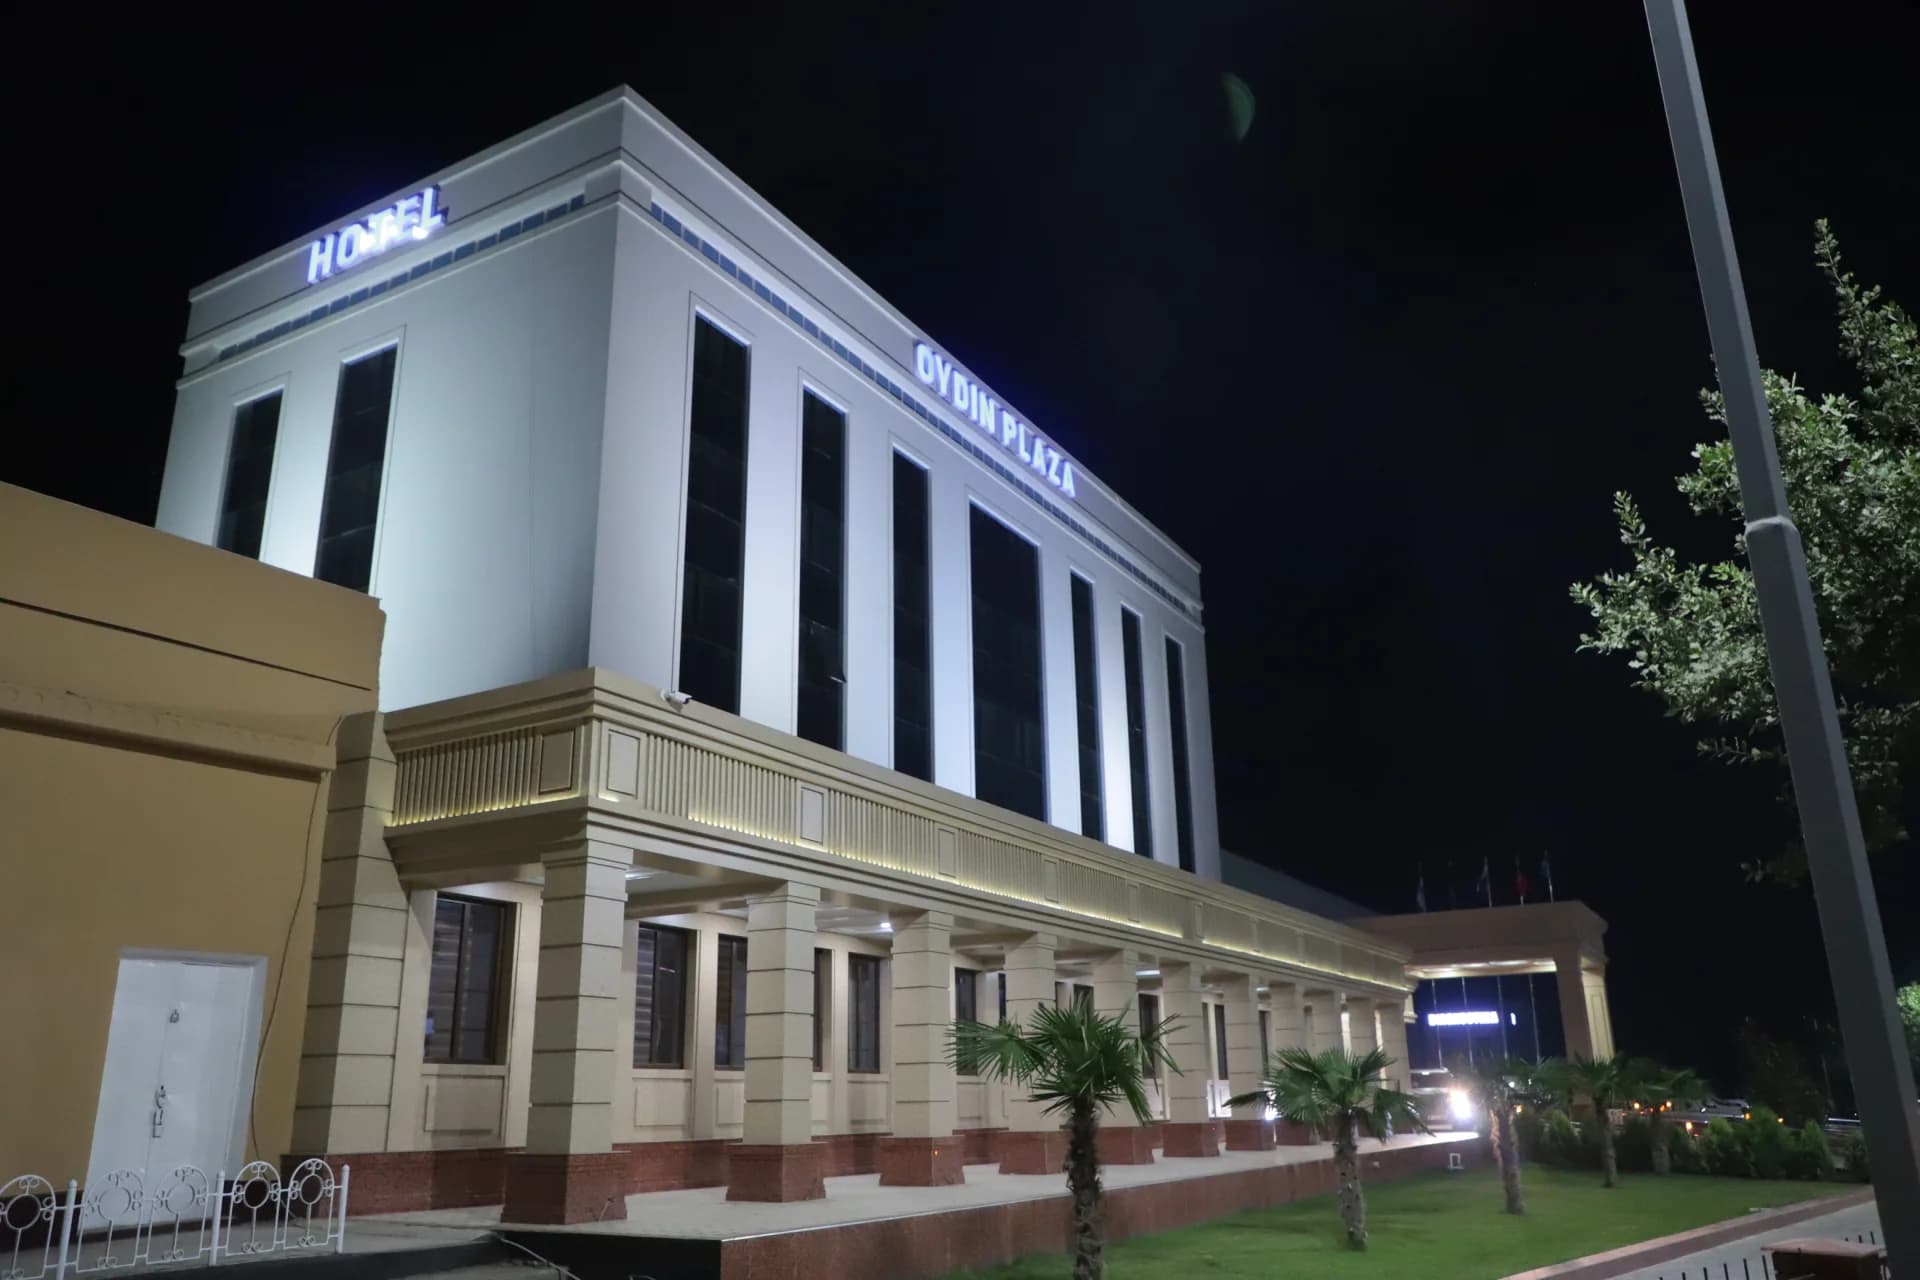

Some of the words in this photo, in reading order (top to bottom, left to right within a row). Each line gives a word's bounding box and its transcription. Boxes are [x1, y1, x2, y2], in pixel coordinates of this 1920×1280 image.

[307, 185, 445, 284] HOTEL
[915, 342, 996, 435] OYDIN
[1002, 409, 1076, 498] PLAZA
